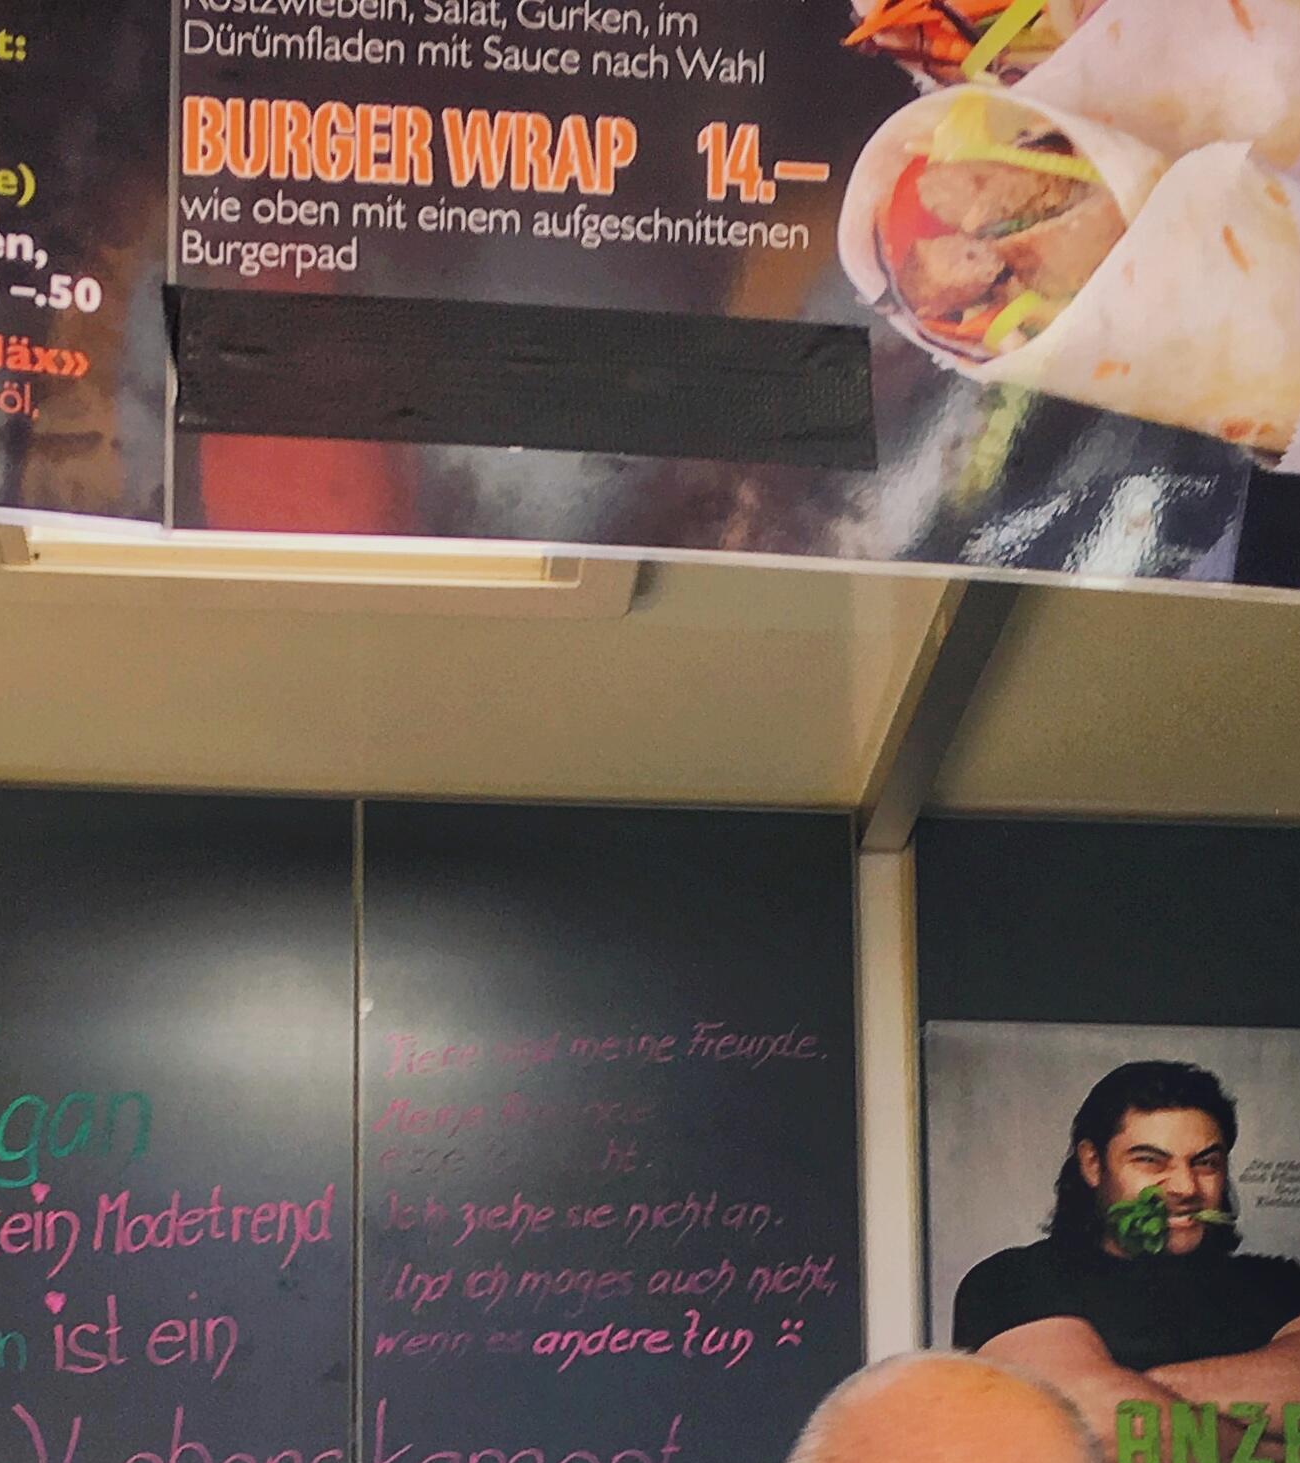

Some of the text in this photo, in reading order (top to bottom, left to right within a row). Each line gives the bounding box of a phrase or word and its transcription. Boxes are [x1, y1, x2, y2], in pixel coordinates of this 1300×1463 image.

[516, 0, 649, 39] Gurken,
[658, 2, 698, 38] im
[183, 19, 766, 85] Dürümfladen mit Sauce nach Wahl
[181, 94, 434, 186] BURGER
[441, 107, 638, 195] WRAP
[180, 192, 810, 251] wie oben mit einem aufgeschnittenen
[181, 232, 358, 276] Burgerpad
[91, 1182, 336, 1270] Modetrend
[647, 1258, 736, 1304] auch
[44, 1291, 129, 1374] ist
[145, 1292, 240, 1381] ein
[532, 1322, 674, 1373] andere
[682, 1309, 756, 1370] tun
